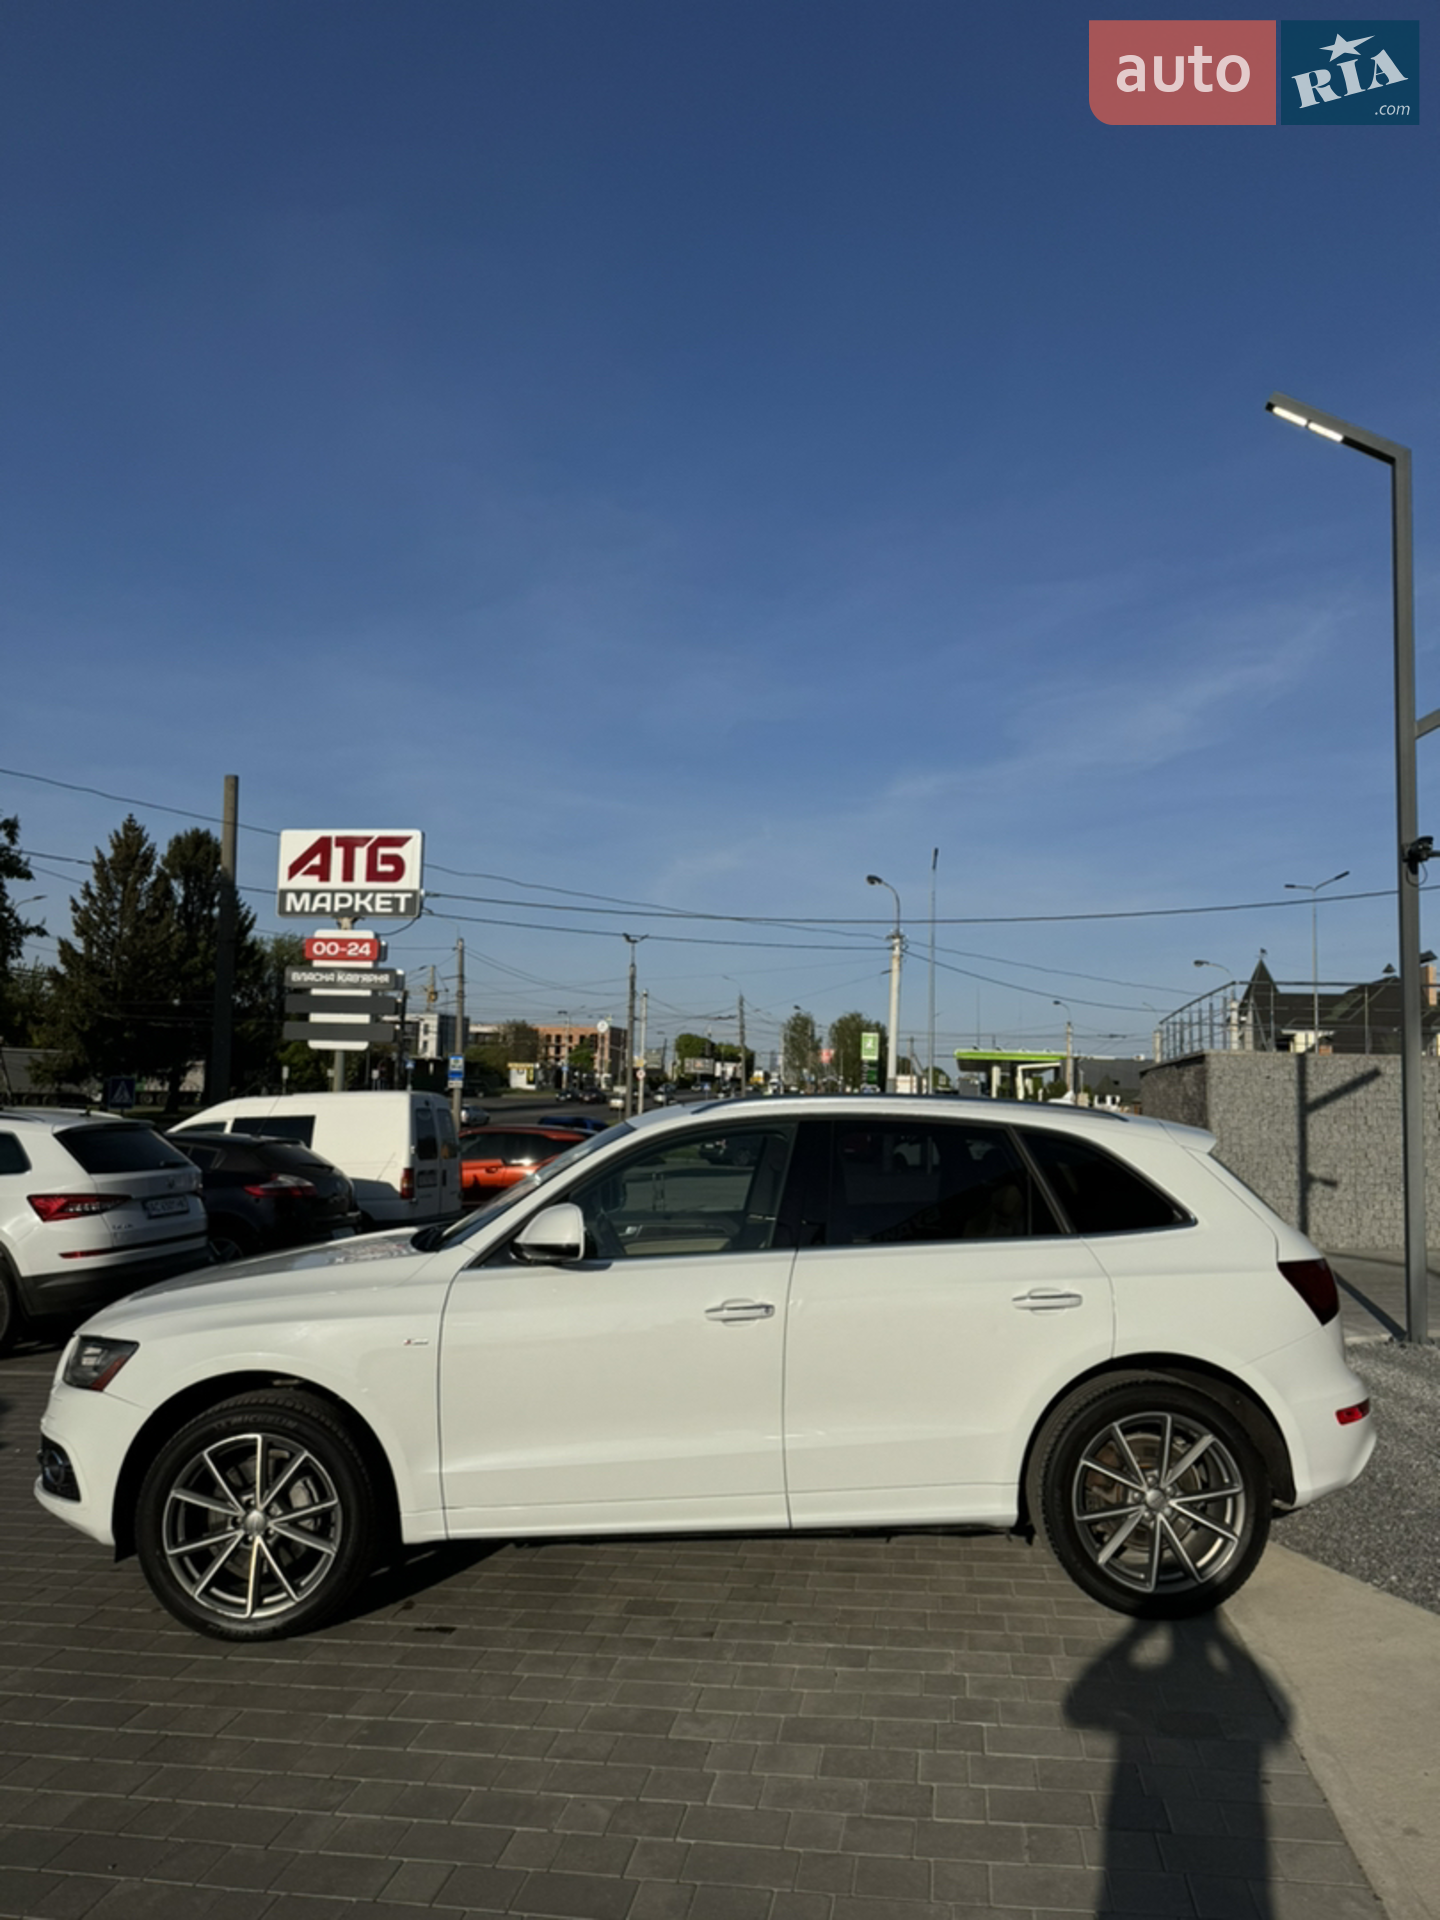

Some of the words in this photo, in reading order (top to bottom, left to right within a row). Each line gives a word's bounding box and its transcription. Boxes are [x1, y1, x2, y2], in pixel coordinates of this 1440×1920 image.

[288, 835, 413, 882] АТБ
[286, 892, 412, 912] МАРКЕТ
[312, 942, 371, 956] 00-24
